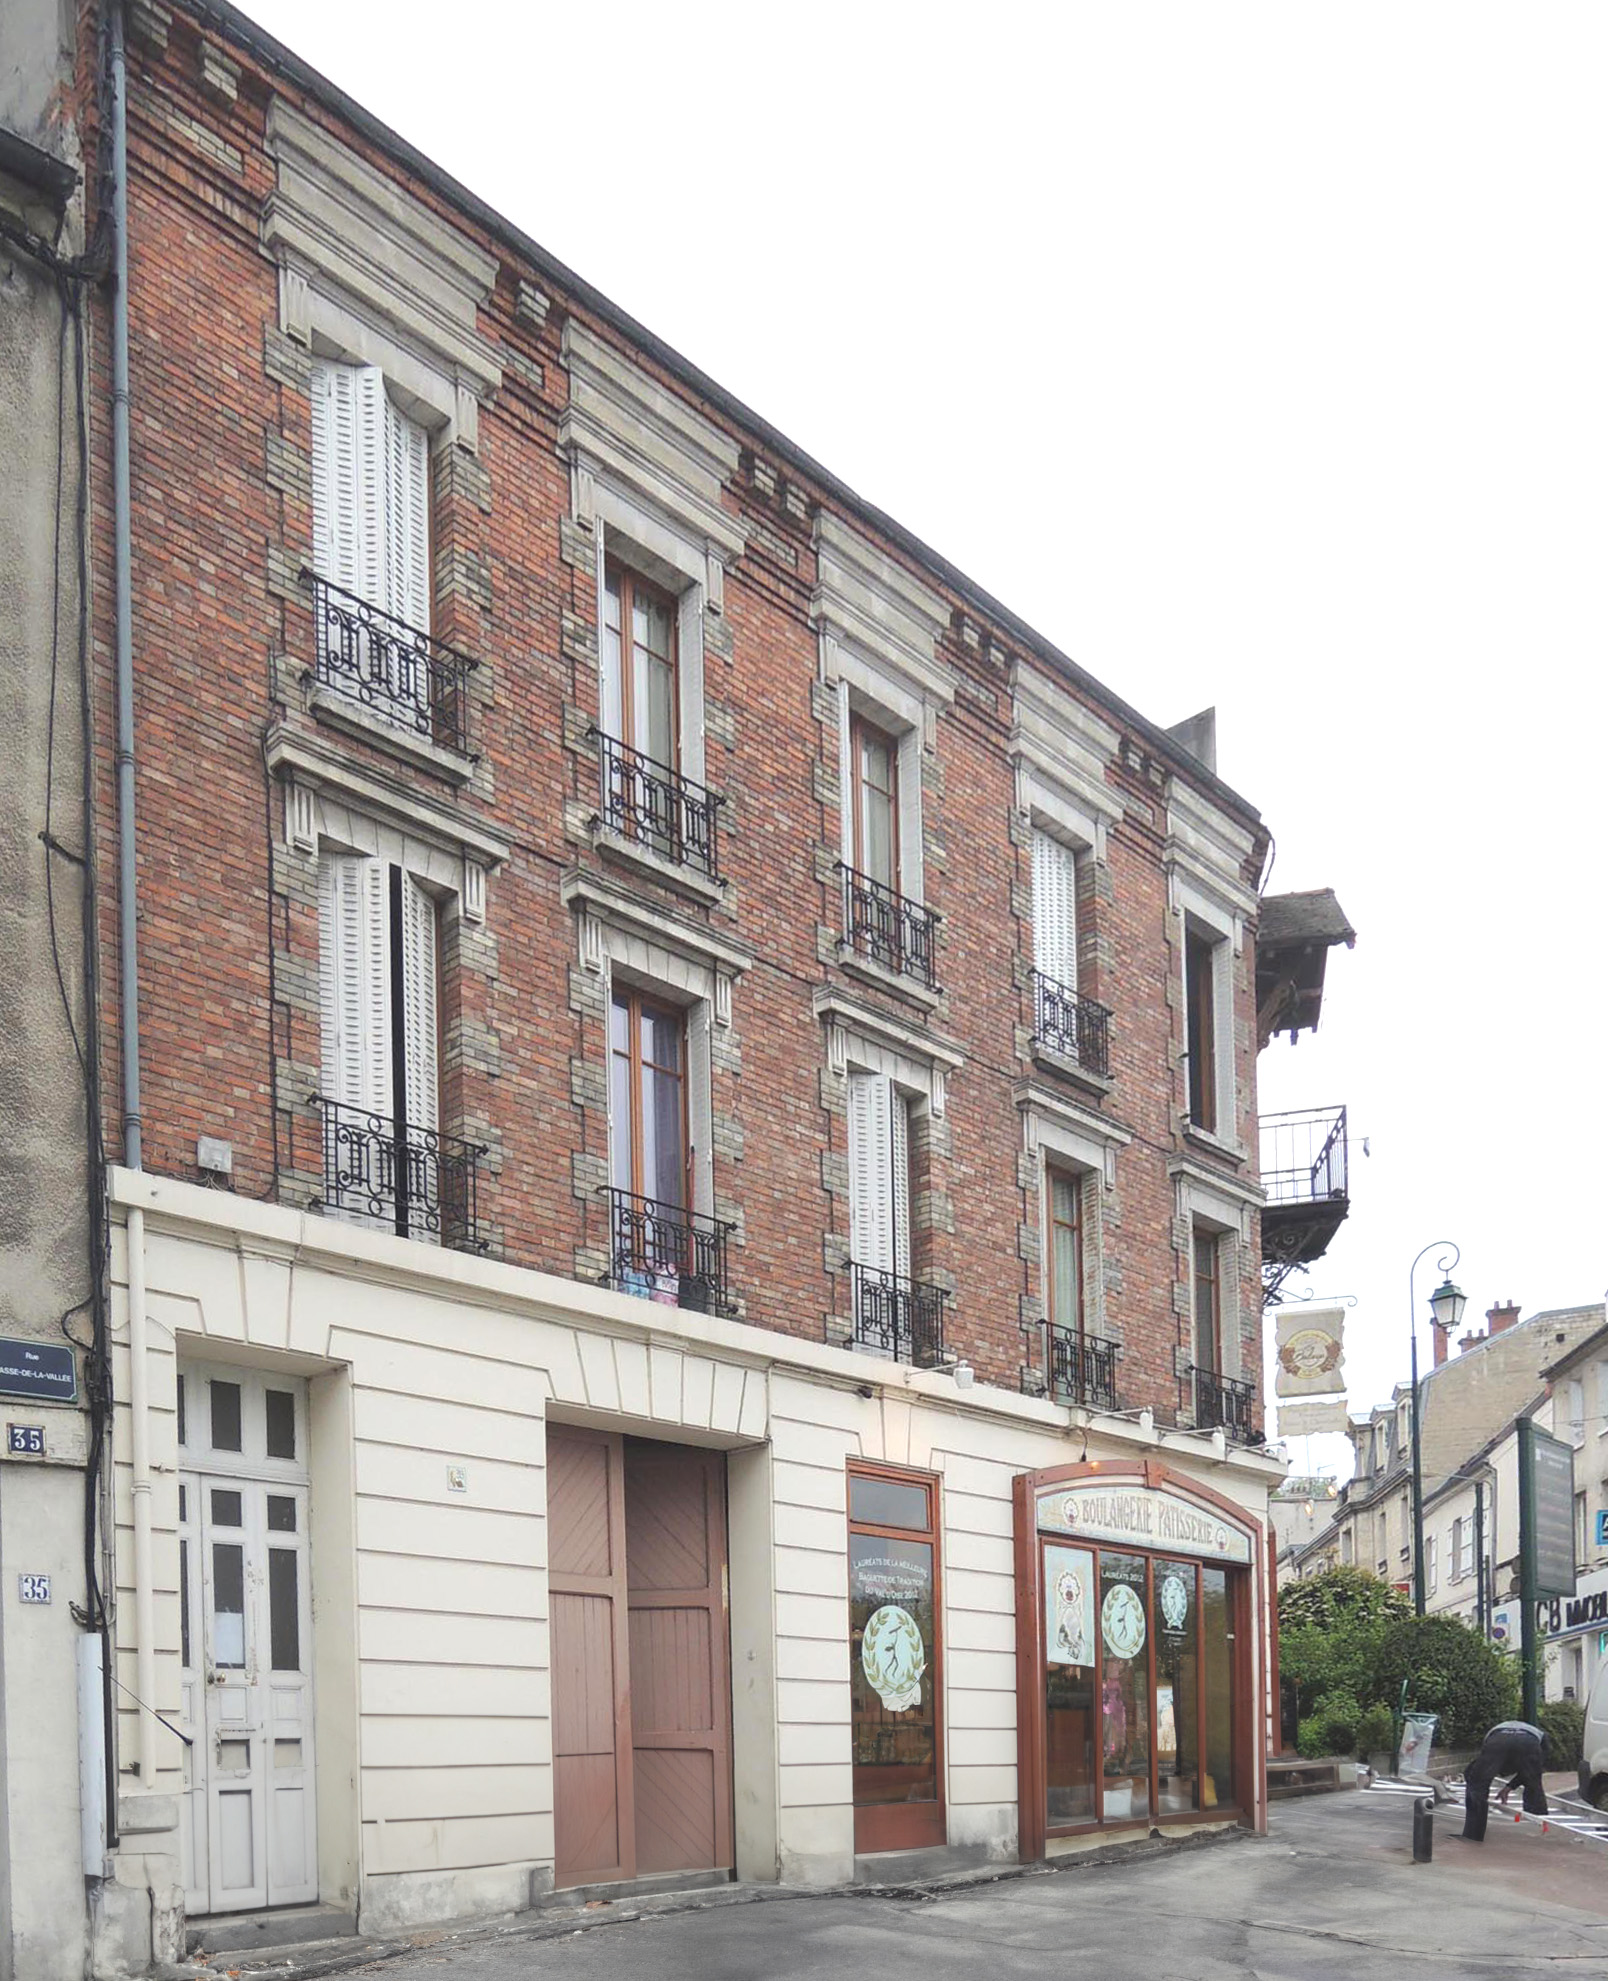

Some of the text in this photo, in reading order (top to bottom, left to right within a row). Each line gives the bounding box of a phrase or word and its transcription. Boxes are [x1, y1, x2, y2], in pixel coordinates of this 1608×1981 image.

[25, 1351, 40, 1361] Rue
[14, 1428, 41, 1451] 35
[1082, 1495, 1213, 1544] BOULANGERIE PATISSERIE
[24, 1576, 48, 1600] 35
[1537, 1597, 1561, 1633] CB
